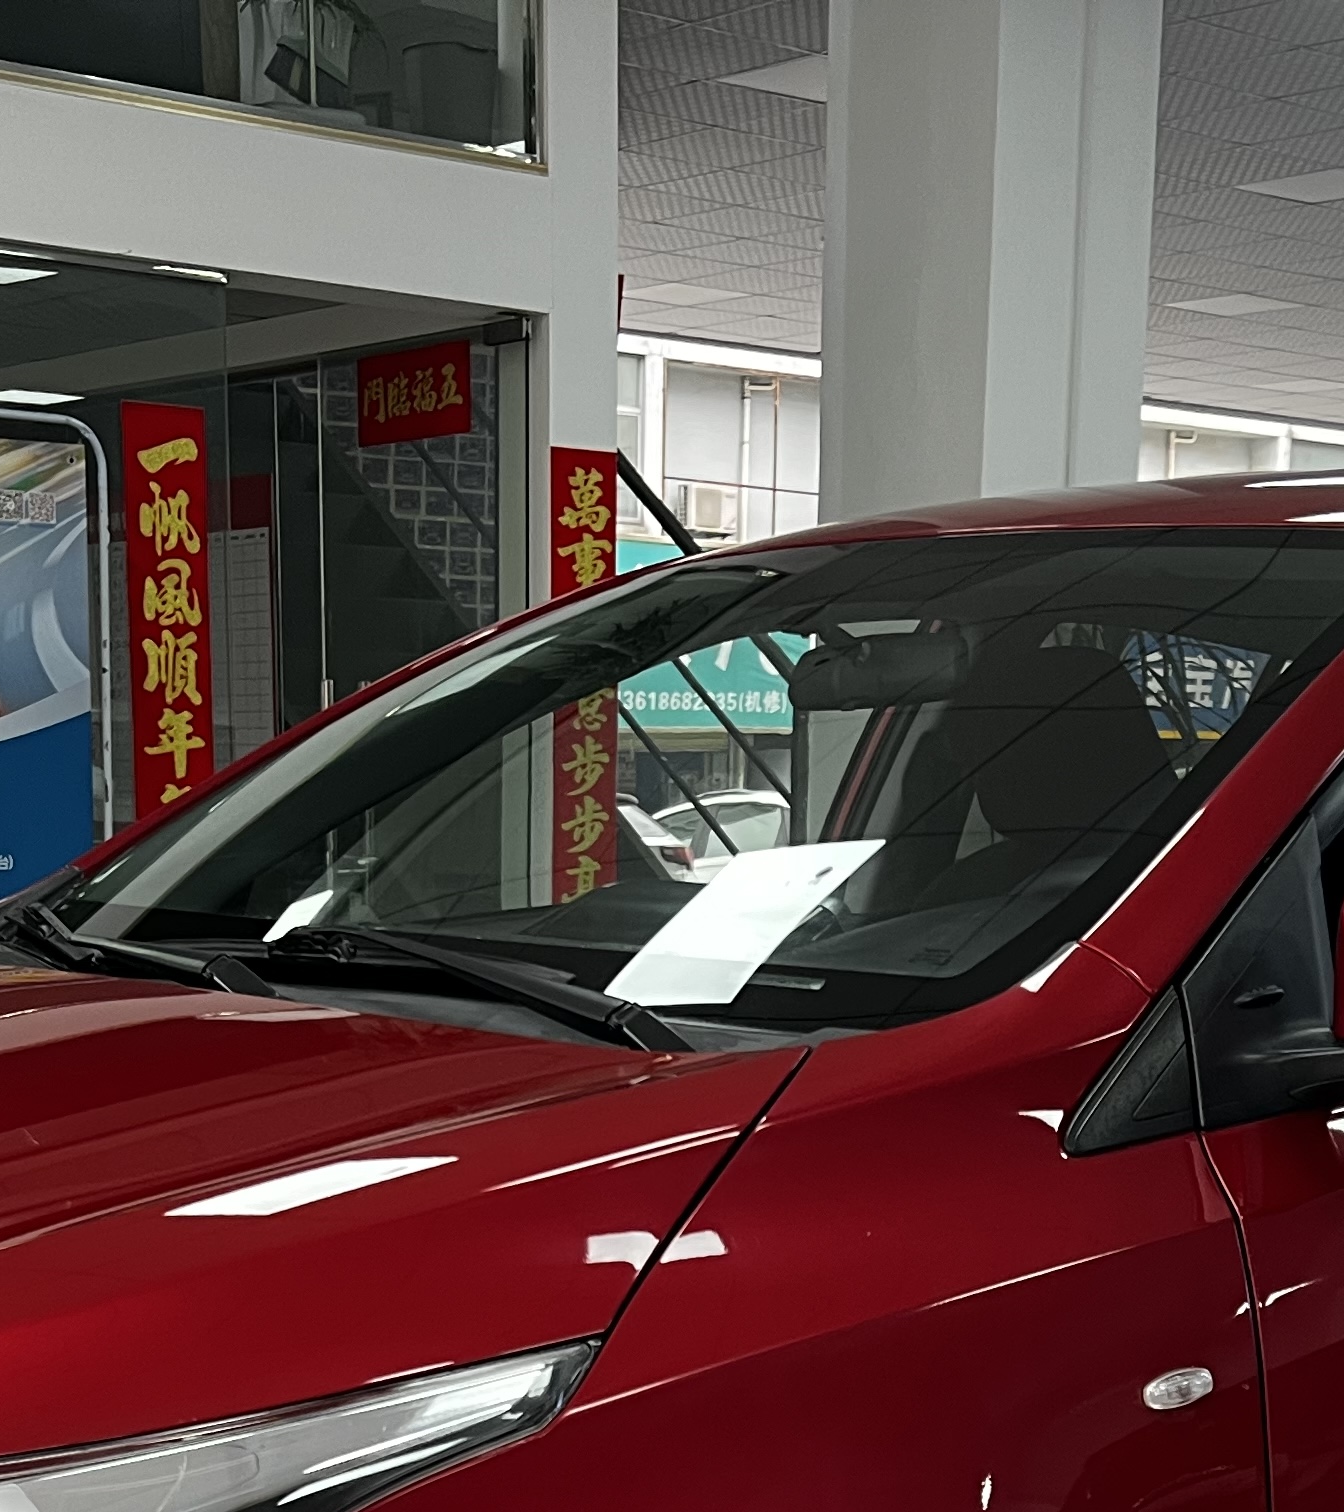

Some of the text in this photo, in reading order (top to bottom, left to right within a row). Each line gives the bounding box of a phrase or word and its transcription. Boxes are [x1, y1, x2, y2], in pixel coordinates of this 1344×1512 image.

[363, 363, 463, 423] 五福臨門
[137, 437, 206, 803] 一帆風順年
